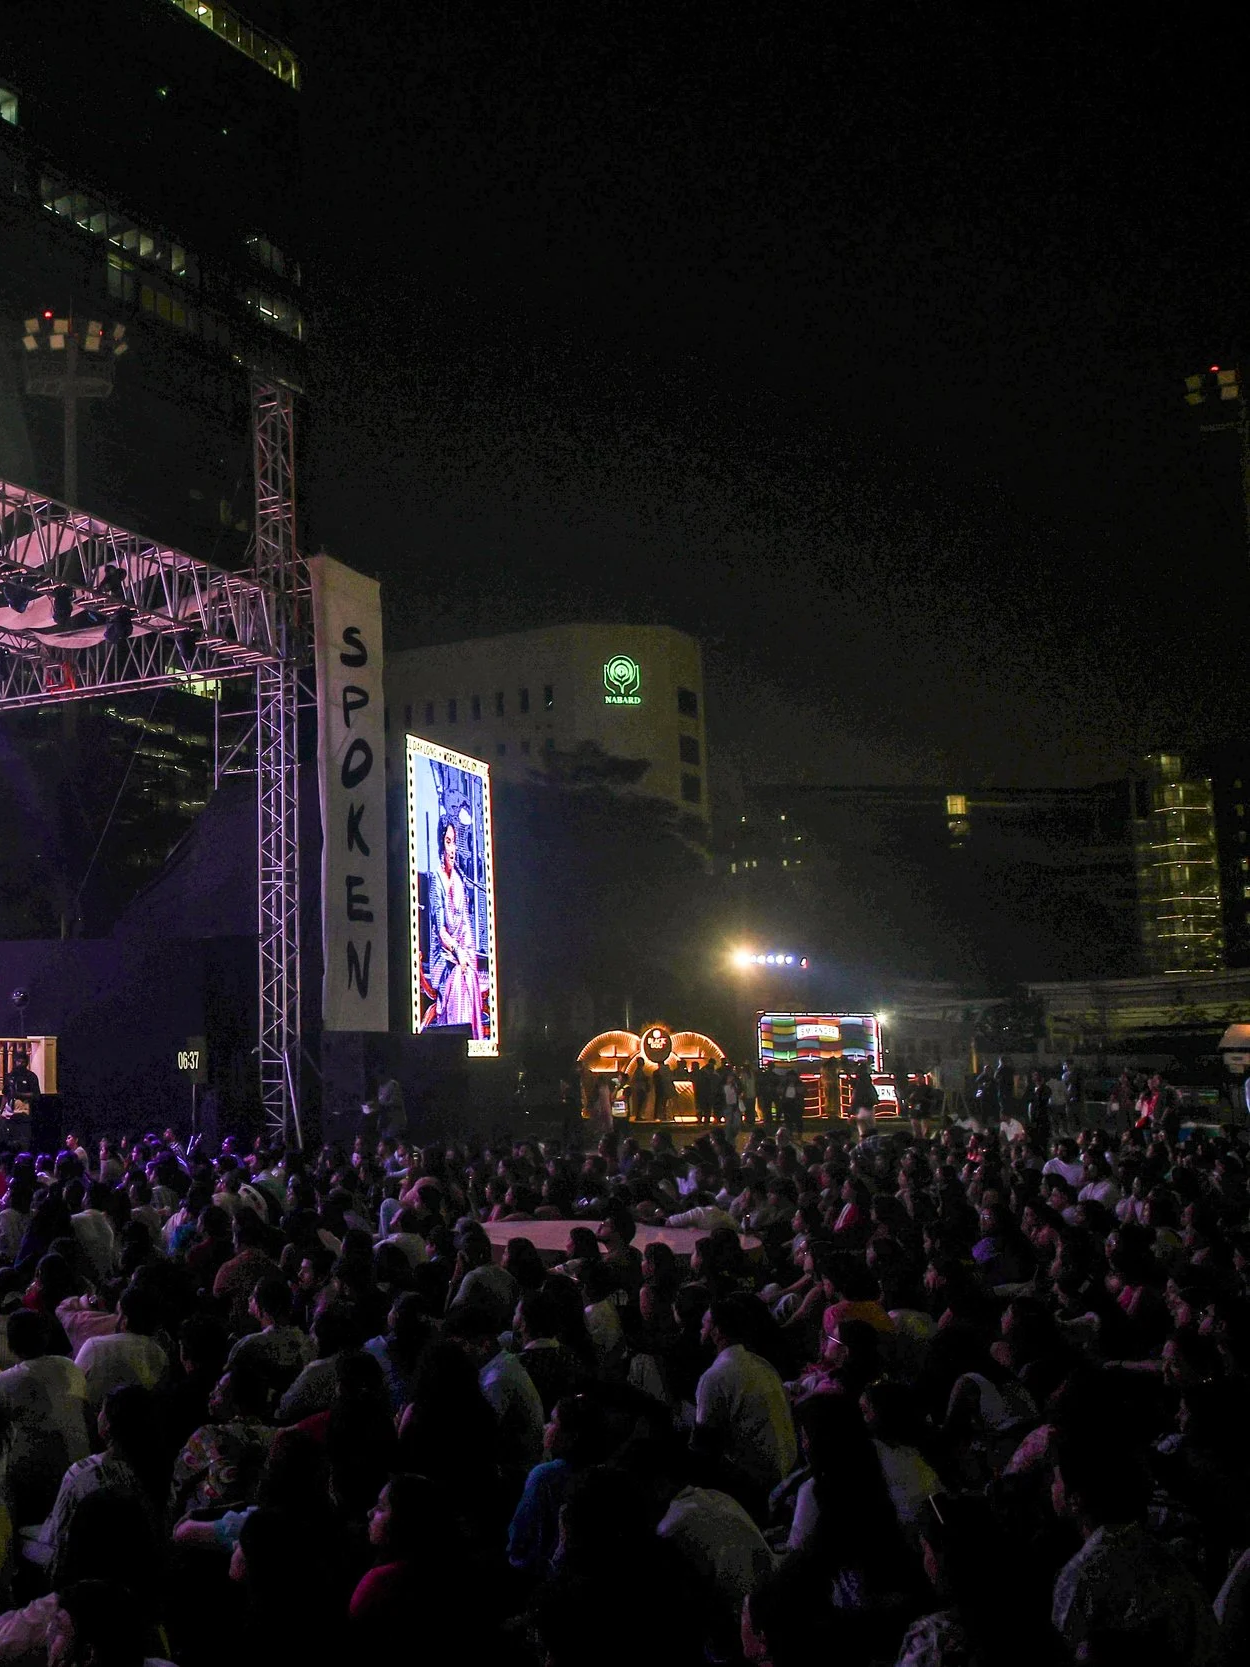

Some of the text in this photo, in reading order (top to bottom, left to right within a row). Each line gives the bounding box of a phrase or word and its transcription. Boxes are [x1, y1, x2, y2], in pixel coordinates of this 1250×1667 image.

[604, 696, 641, 704] NABARD
[339, 626, 374, 999] SPOKEN
[177, 1051, 200, 1070] 06:37
